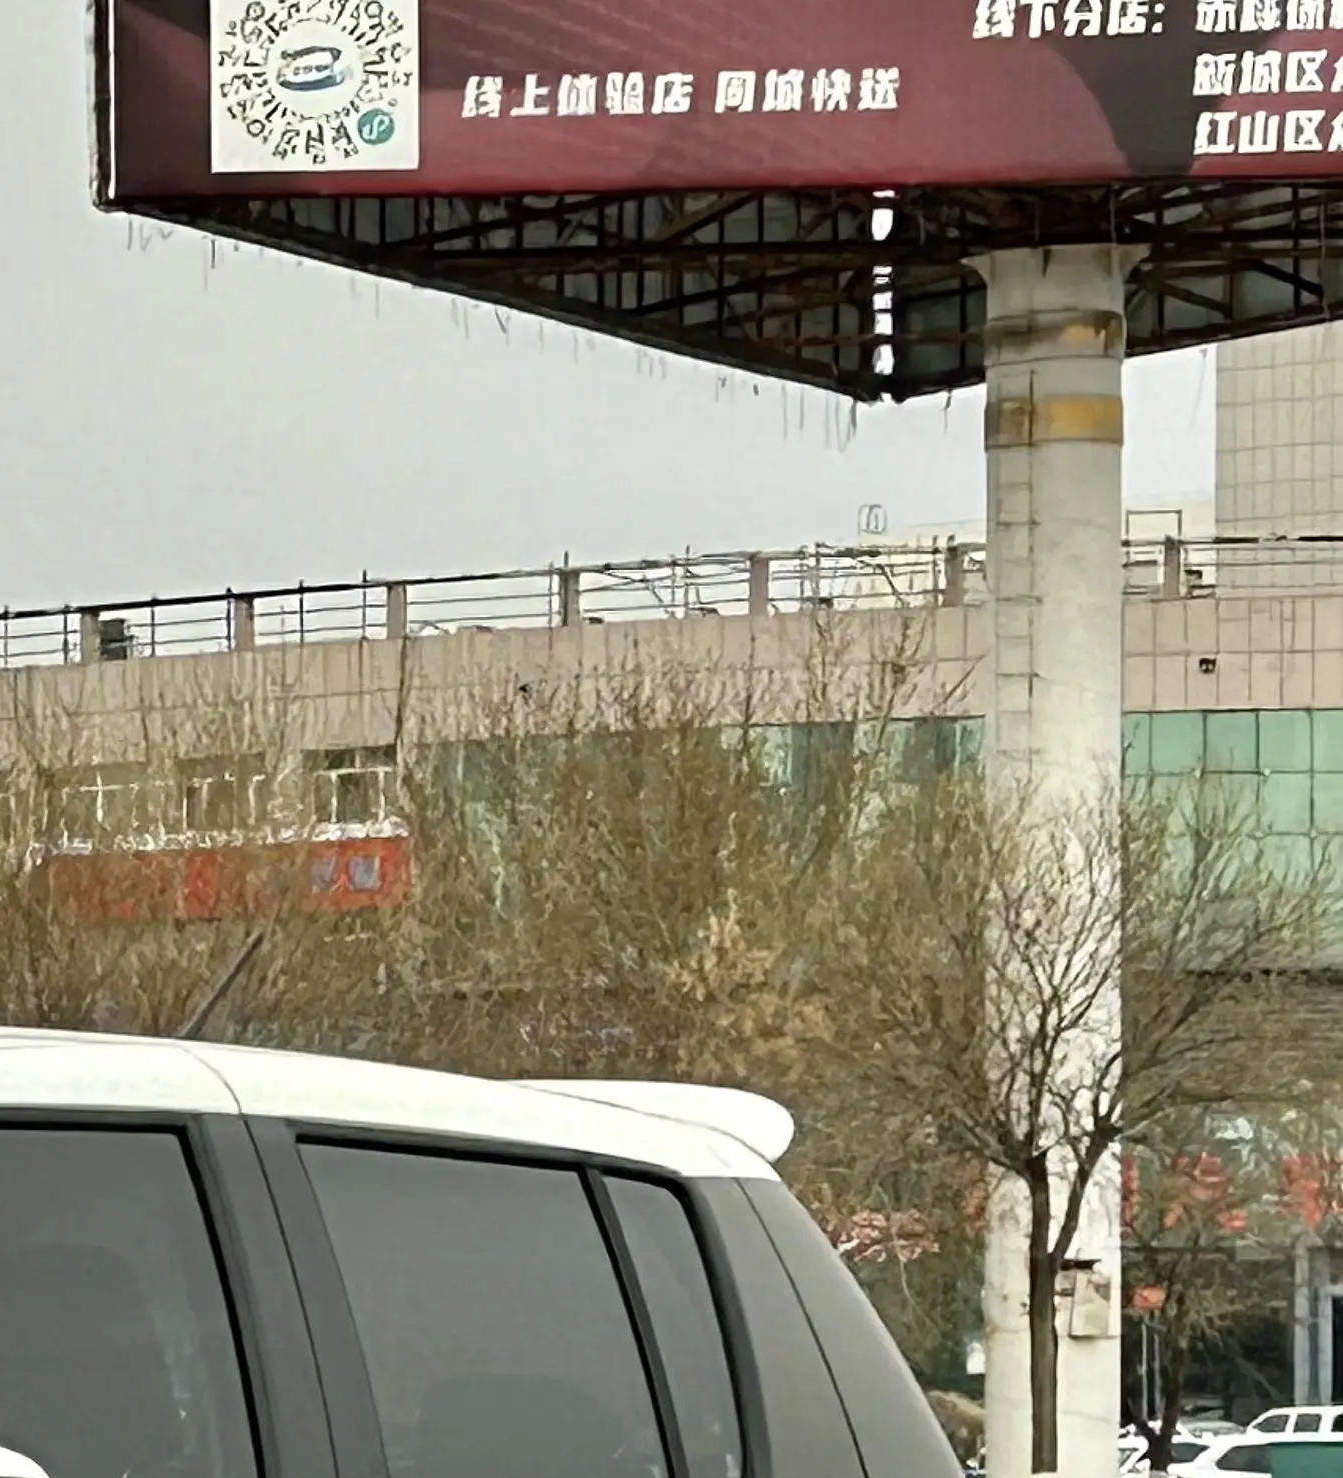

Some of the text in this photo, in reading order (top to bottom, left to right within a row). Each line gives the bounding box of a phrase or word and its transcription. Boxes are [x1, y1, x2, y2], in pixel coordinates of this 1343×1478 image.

[462, 67, 901, 118] 线上体验店 同城快送
[1192, 48, 1343, 96] 新城区
